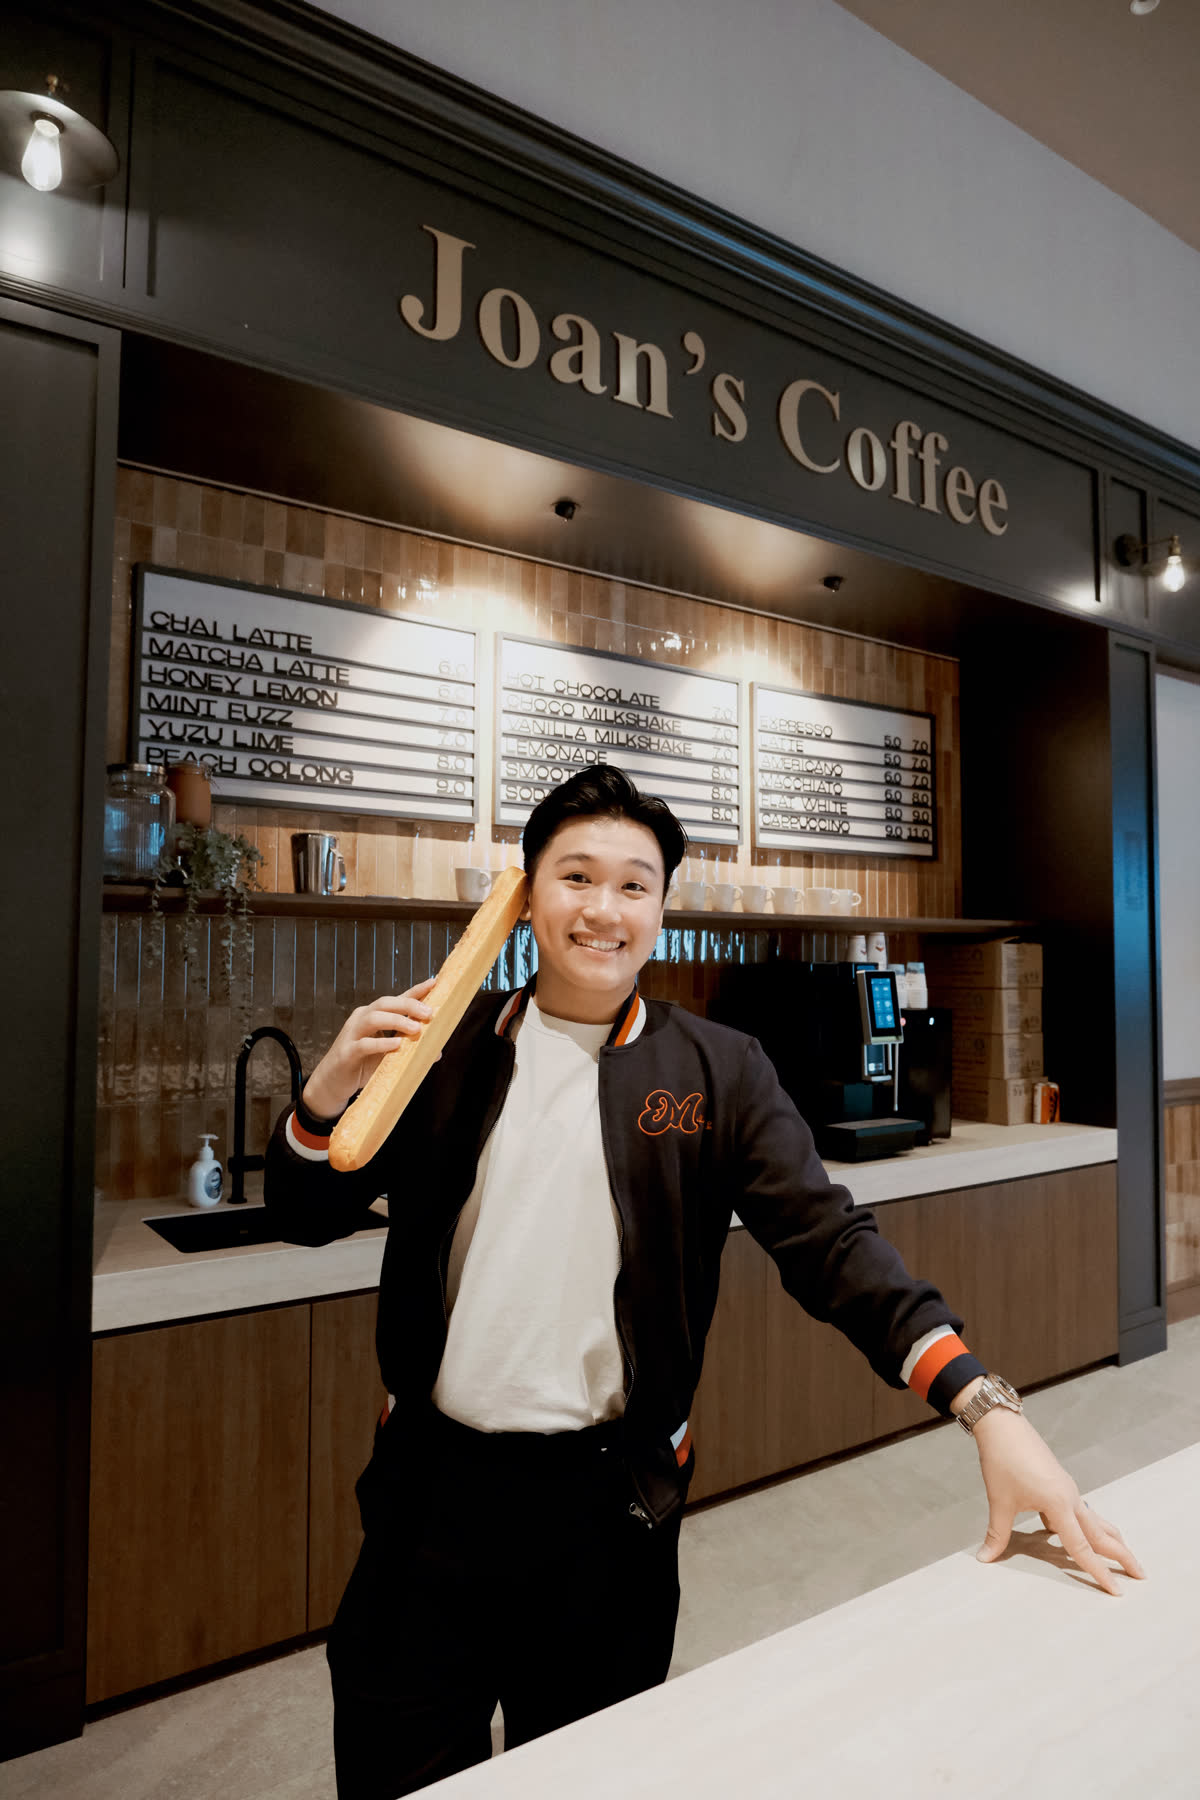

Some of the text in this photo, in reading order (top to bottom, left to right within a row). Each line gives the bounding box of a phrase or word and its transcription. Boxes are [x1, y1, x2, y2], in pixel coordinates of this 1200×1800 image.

[400, 224, 1009, 537] Joan's Coffee
[150, 611, 222, 640] CHAI
[233, 624, 313, 653] LATTE
[149, 637, 264, 672] MATCHA
[274, 657, 350, 685] LATTE
[148, 665, 242, 694] HONEY
[253, 680, 338, 708] LEMON
[507, 672, 545, 691] HOT
[553, 679, 660, 710] CHOCOLATE
[147, 692, 467, 747] MINT FUZZ 7.0
[507, 694, 575, 717] CHOCO
[582, 706, 682, 734] MILKSHAKE
[148, 719, 467, 772] YUZU LIME 8.0
[507, 718, 587, 742] VANILLA
[594, 728, 693, 757] MILKSHAKE
[760, 735, 929, 771] LATTE 5.0 7.0
[883, 735, 902, 749] 5.0
[911, 739, 929, 754] 7.0
[248, 758, 354, 785] OOLONG
[436, 778, 466, 795] 9.0
[505, 737, 733, 782] LEMONADE 8.0
[760, 755, 929, 789] AMERICANO 6.0 7.0
[505, 762, 733, 802] SMOOT 8.0
[760, 773, 929, 807] MACCHIATO 6.0 8.0
[505, 785, 733, 822] SOD 8.0
[760, 793, 930, 825] FLAT WHITE 8.0 9.0
[761, 812, 930, 842] CAPPUCCINO 9.0 11.0
